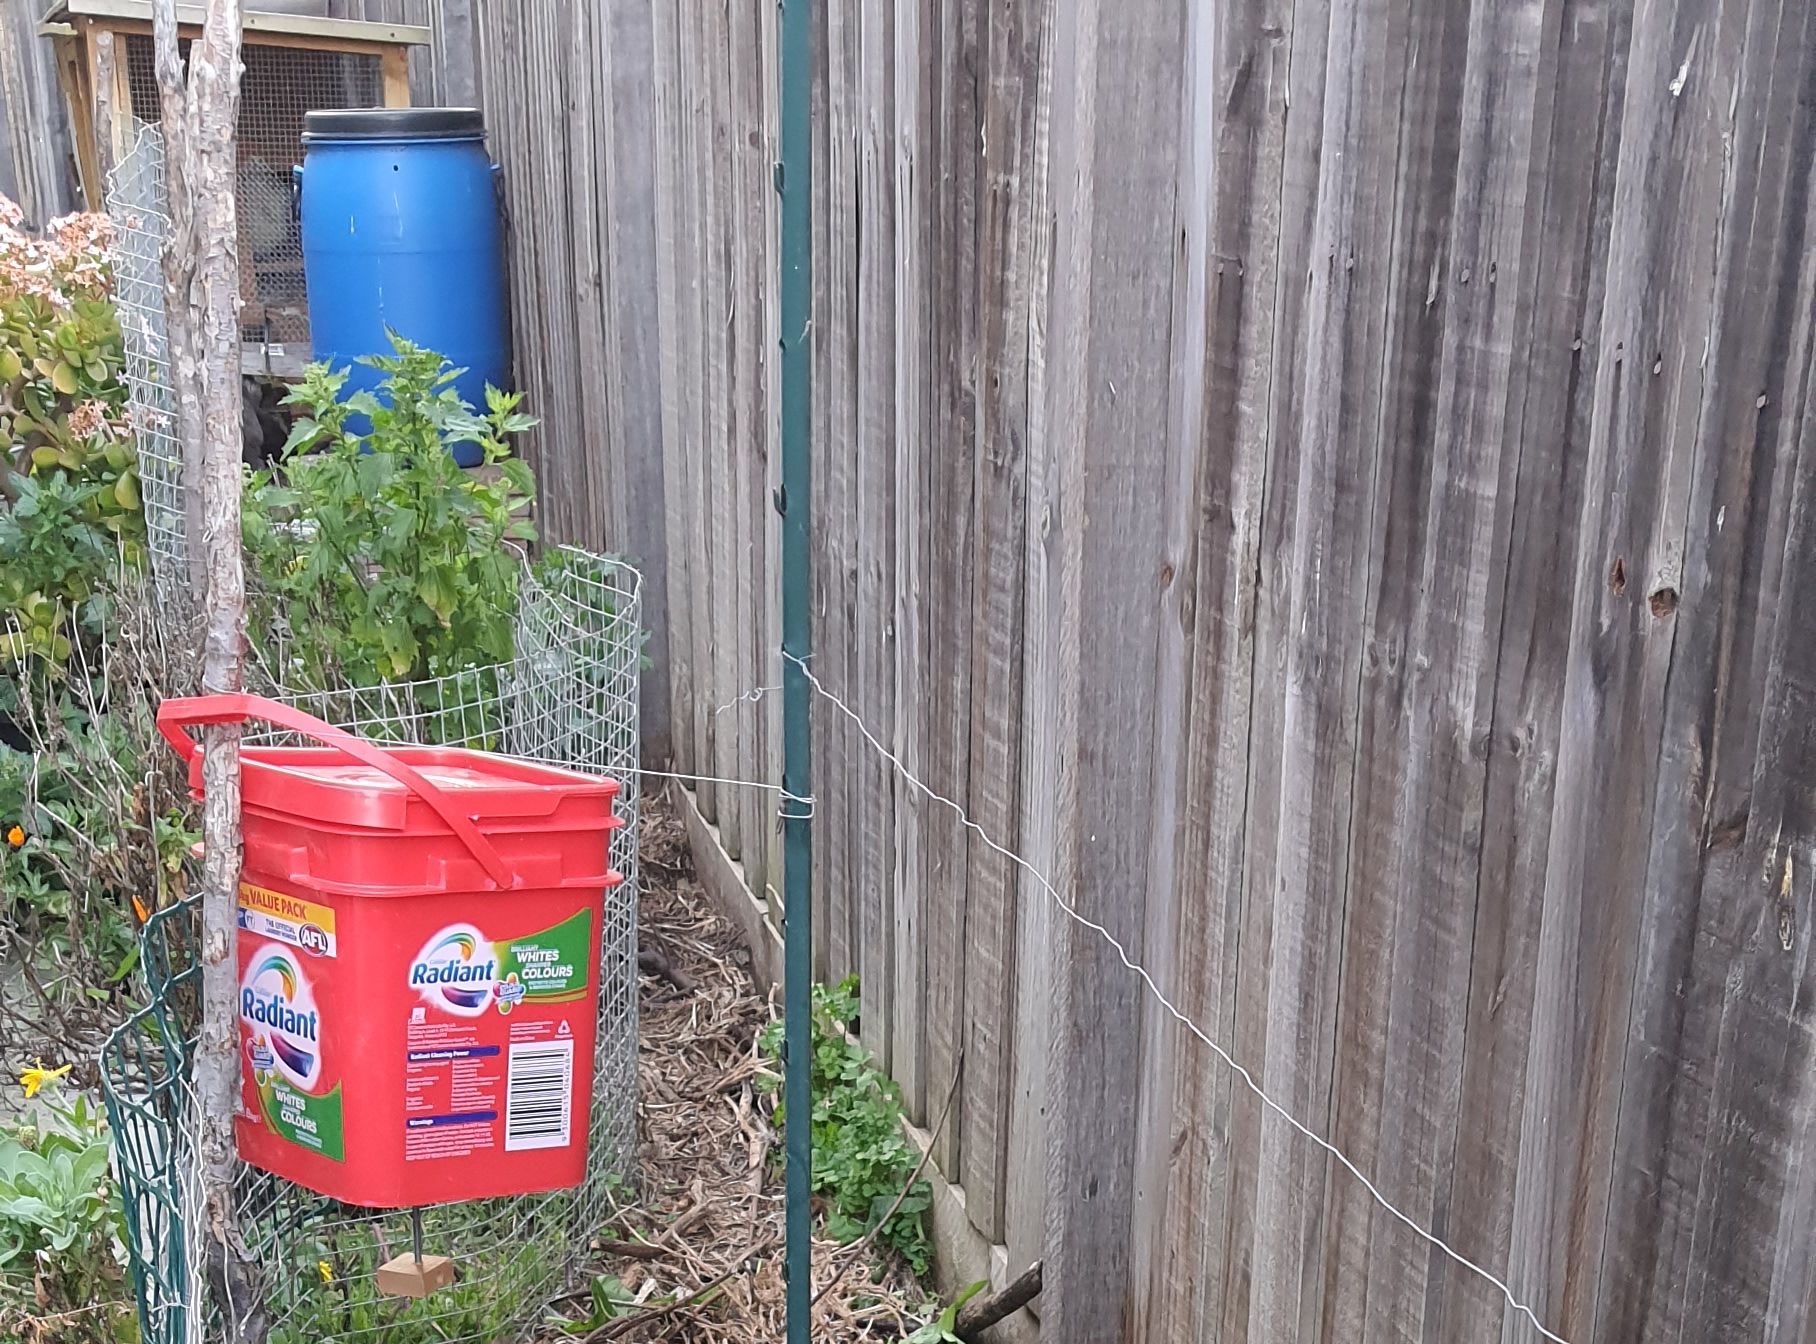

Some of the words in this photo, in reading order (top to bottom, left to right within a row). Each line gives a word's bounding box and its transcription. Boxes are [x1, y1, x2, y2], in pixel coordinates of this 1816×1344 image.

[249, 888, 280, 912] VALUE
[281, 898, 307, 921] PACK
[301, 929, 327, 952] AFL
[516, 949, 560, 963] WHITES
[412, 959, 494, 985] Radiant
[522, 964, 573, 979] COLOURS
[242, 987, 317, 1042] Radiant
[275, 1089, 306, 1111] WHITES
[281, 1110, 317, 1134] COLOURS
